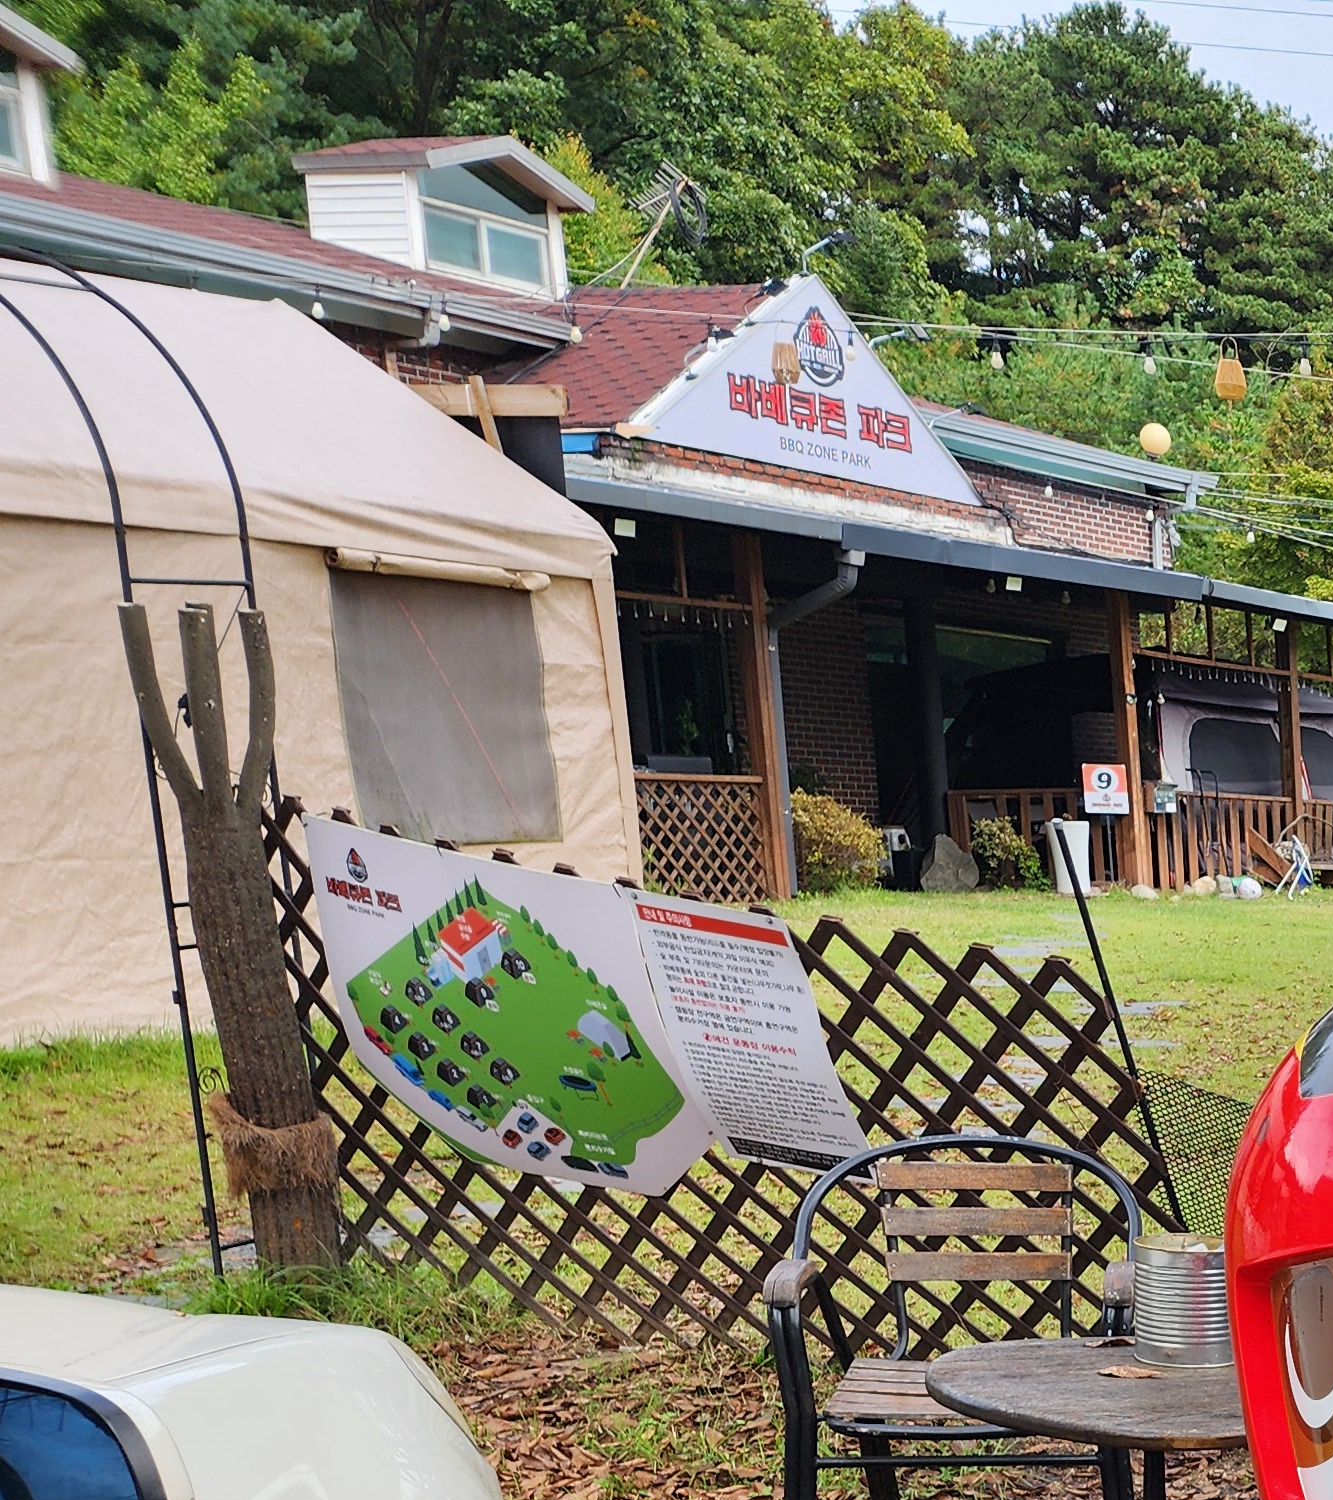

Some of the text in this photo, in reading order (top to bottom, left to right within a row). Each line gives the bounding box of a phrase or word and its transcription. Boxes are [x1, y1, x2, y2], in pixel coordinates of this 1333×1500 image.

[796, 338, 816, 361] HOT
[816, 347, 842, 370] GRILL
[727, 371, 912, 454] 바베큐존 파크
[780, 436, 871, 469] BBQ ZONE PARK
[1097, 772, 1112, 789] 9
[654, 928, 677, 940] 반려동물
[657, 940, 680, 952] 외부음식
[670, 954, 680, 962] 부족
[727, 963, 752, 976] 카운터에
[756, 968, 768, 978] 문의
[719, 993, 737, 1004] 보호자
[763, 1001, 774, 1010] 이용
[778, 1003, 790, 1013] 가능
